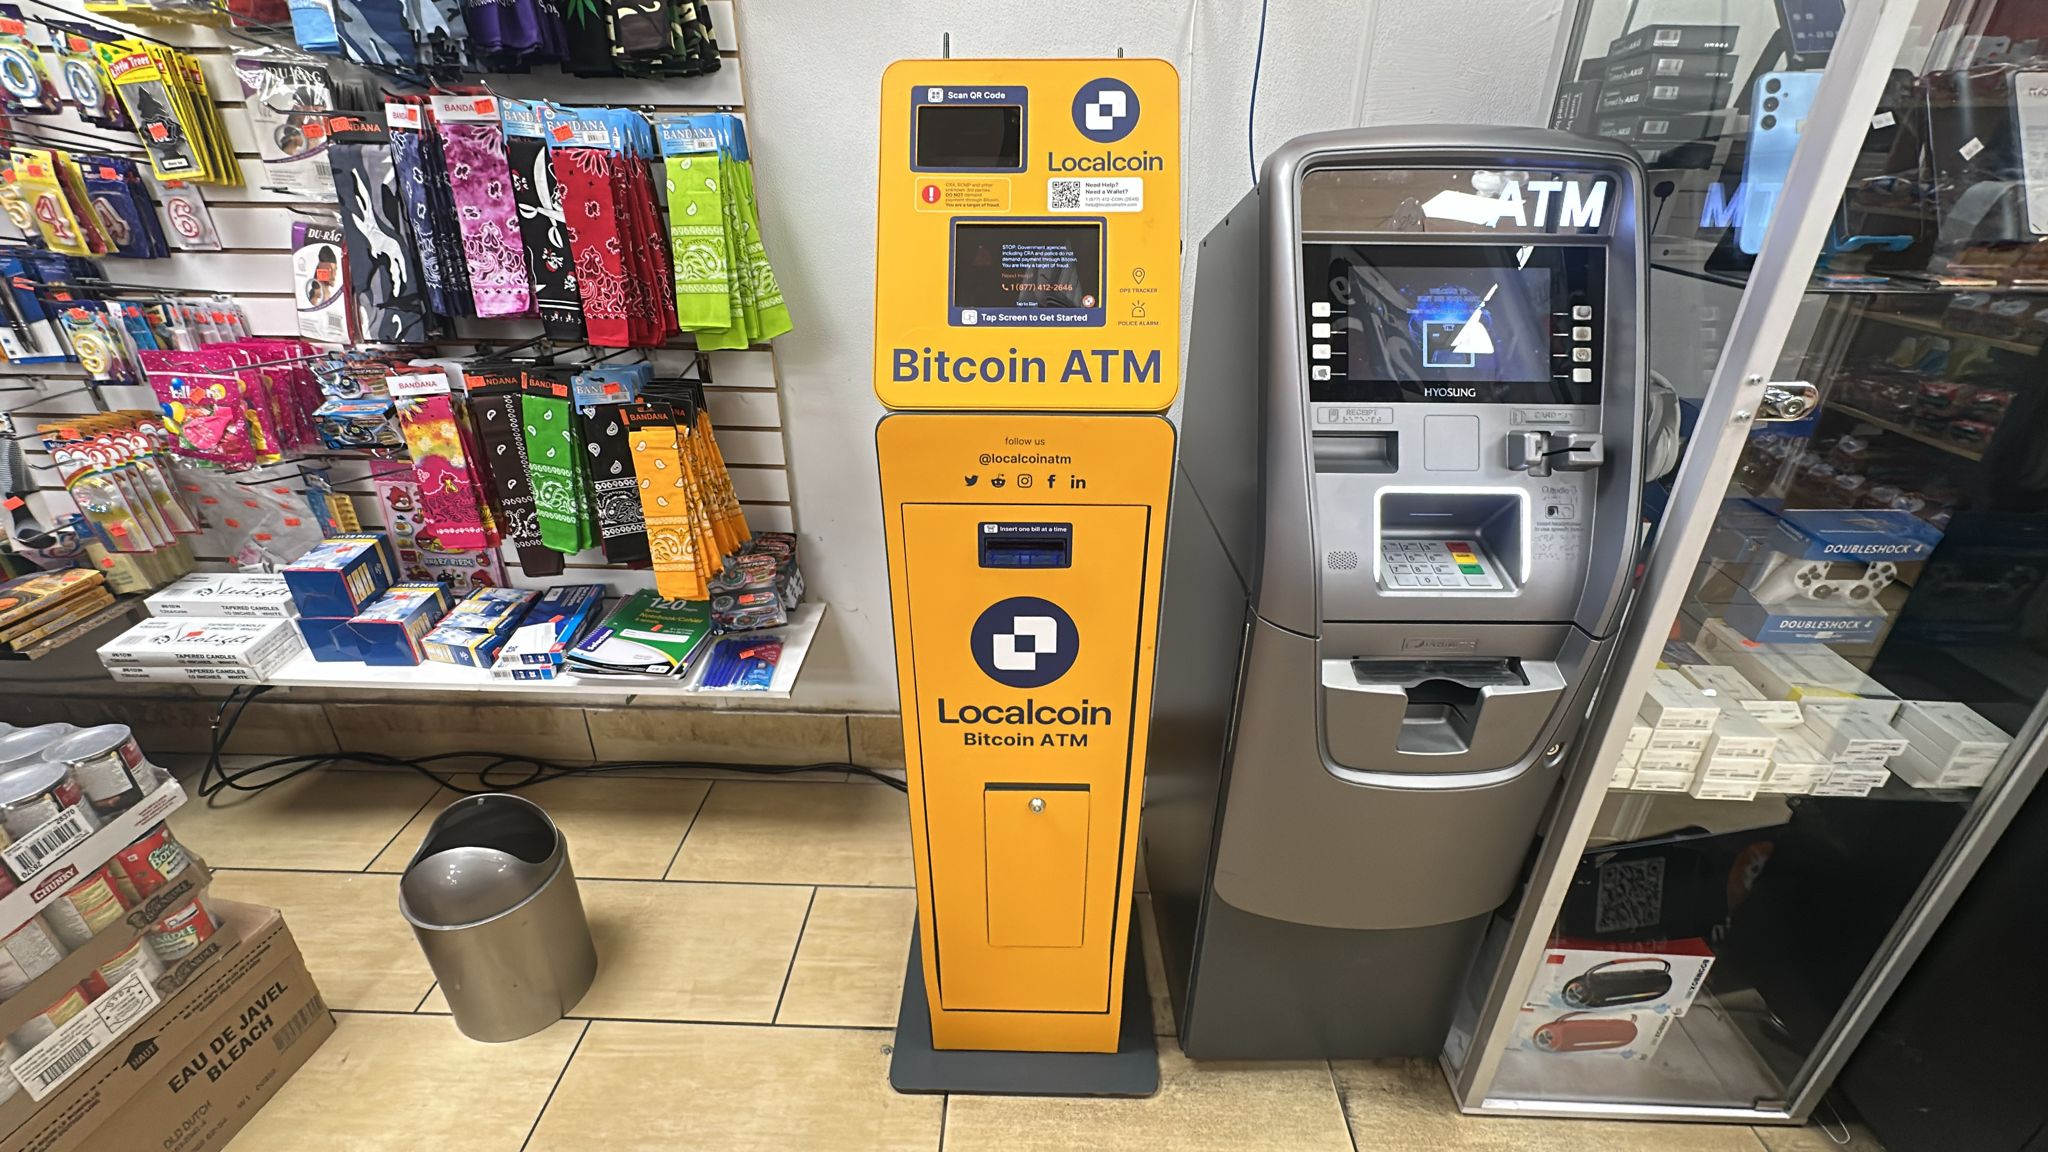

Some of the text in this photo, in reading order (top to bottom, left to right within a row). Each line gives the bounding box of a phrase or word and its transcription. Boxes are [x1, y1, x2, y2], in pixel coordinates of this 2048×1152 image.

[107, 56, 151, 79] Little Trees
[947, 91, 1006, 100] Scan QR Code
[444, 104, 475, 112] BANDA
[392, 111, 408, 120] BANDA
[348, 123, 381, 132] NDANA
[663, 128, 715, 139] BANDANA
[1048, 151, 1163, 172] Localcoin
[1487, 180, 1607, 228] ATM
[1015, 283, 1035, 291] (877)
[981, 313, 1088, 323] Tap Screen to Get Started
[893, 347, 1161, 383] Bitcoin ATM
[398, 380, 438, 389] BANDANA
[485, 376, 518, 386] NDANA
[1424, 388, 1476, 398] HYOSUNG
[630, 412, 668, 421] BANDANA
[1005, 437, 1045, 446] follow us
[979, 453, 1072, 466] @localcoinatm
[1824, 544, 1922, 554] DOUBLESHOCK 4
[649, 597, 687, 611] 120
[1779, 620, 1860, 629] DOUBLESHOCK
[938, 698, 1111, 726] Localcoin
[964, 732, 1088, 747] Bitcoin ATM
[56, 808, 76, 825] 28370
[33, 867, 76, 900] CHUNKY
[168, 1052, 208, 1094] EAU
[209, 1025, 238, 1055] DE
[239, 981, 289, 1031] JAVEL
[206, 1014, 275, 1083] BLEACH
[132, 1043, 156, 1068] HAUT
[182, 1100, 212, 1131] DUTCH
